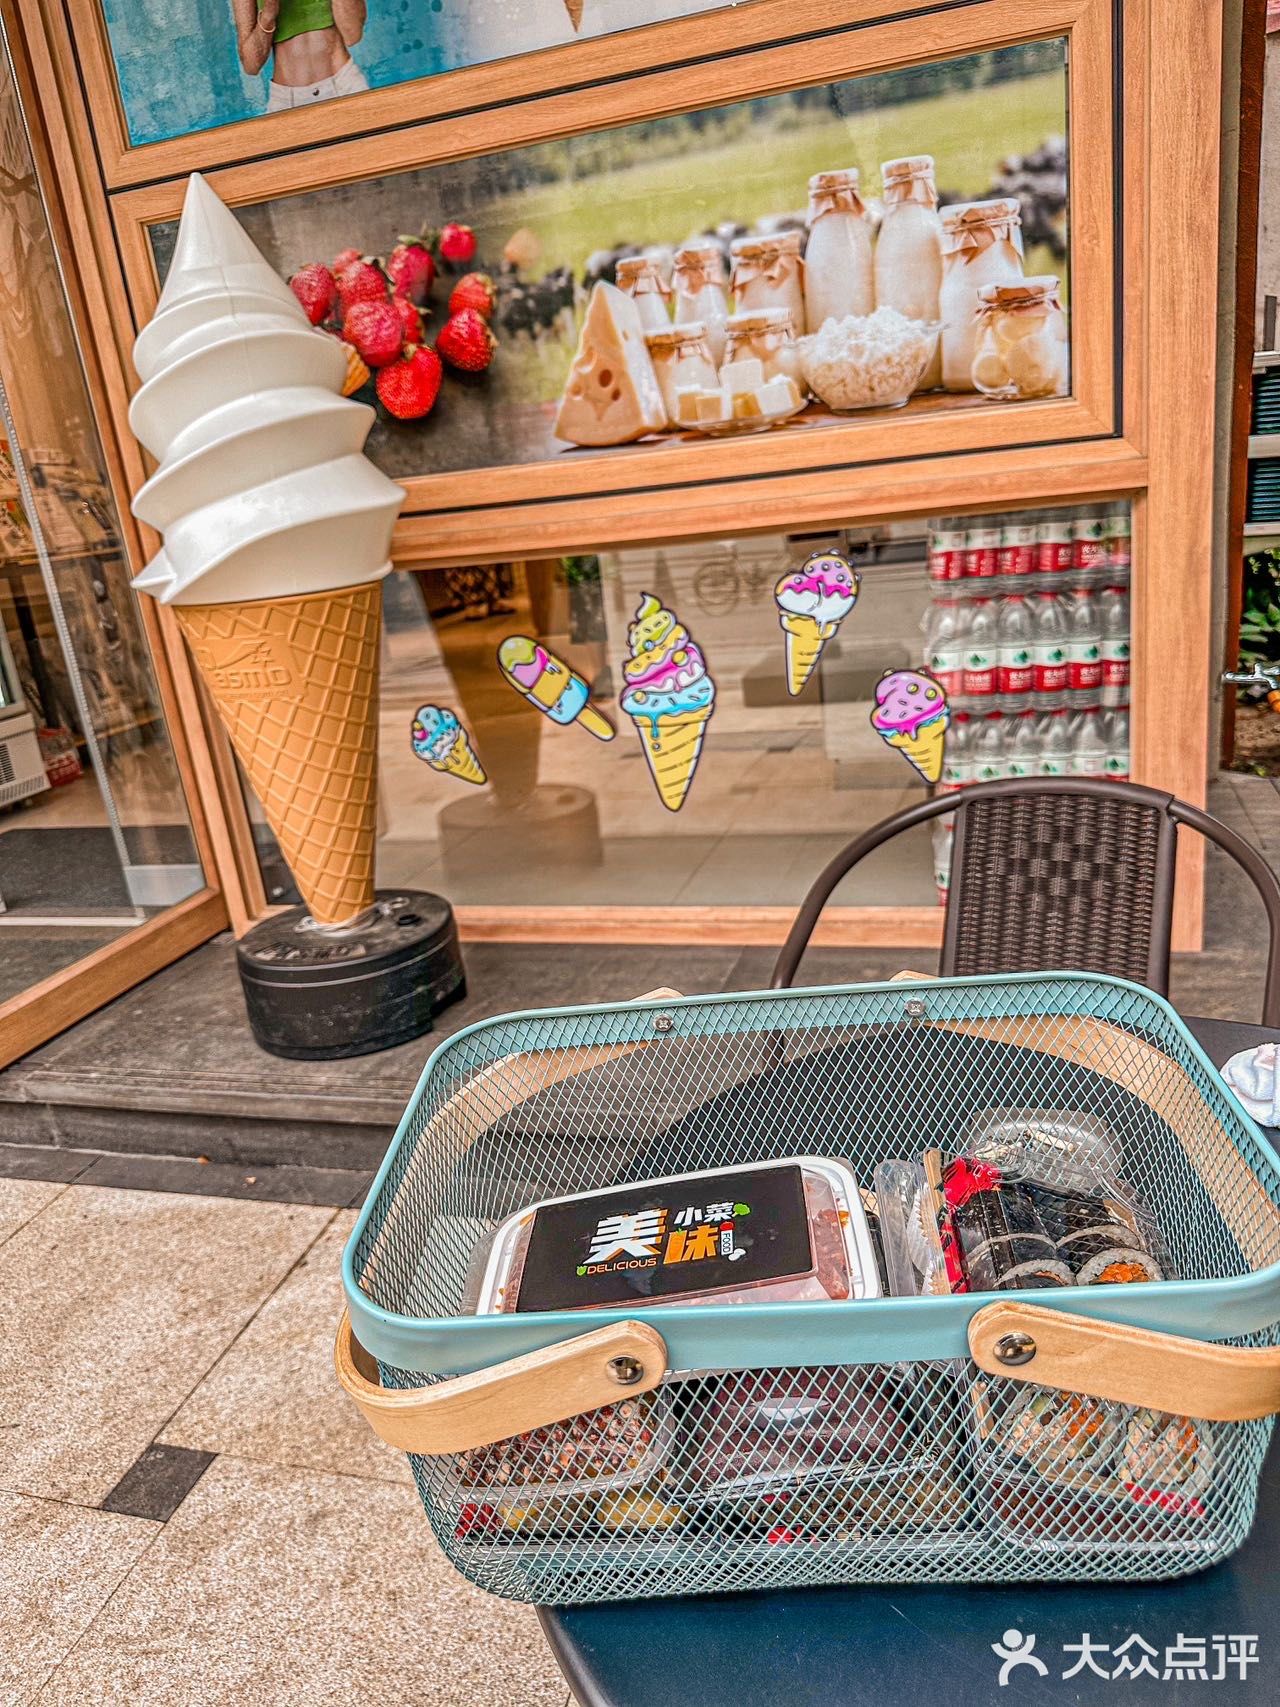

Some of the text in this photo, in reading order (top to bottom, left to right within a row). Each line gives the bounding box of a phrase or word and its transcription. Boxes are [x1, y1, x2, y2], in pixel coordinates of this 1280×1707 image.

[674, 1201, 734, 1227] 小菜
[582, 1207, 719, 1265] 美味
[721, 1232, 732, 1255] FOOD
[586, 1257, 658, 1276] DELICIOUS
